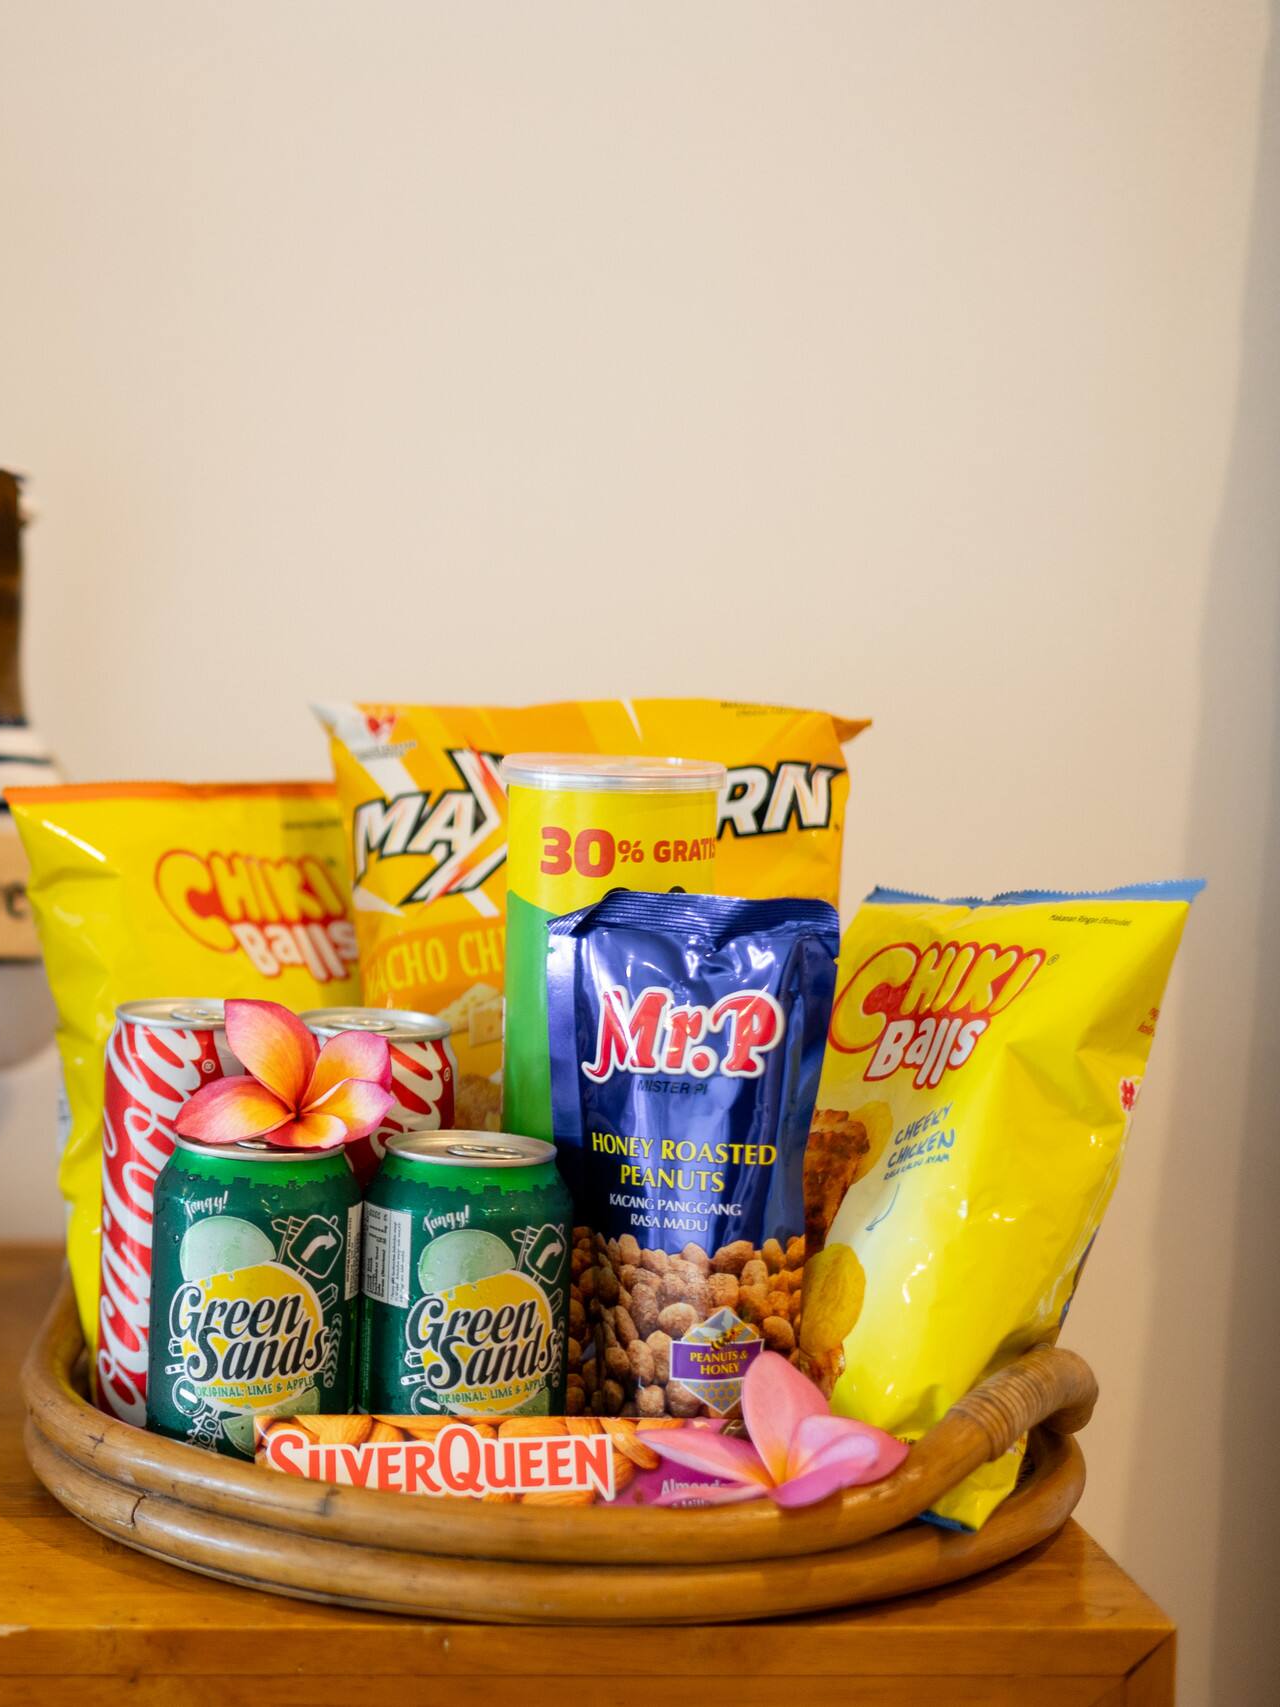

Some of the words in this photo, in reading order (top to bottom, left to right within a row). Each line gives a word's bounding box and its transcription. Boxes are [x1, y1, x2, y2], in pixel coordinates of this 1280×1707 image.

[540, 826, 645, 878] 30%
[154, 848, 348, 954] CHIKI
[232, 919, 359, 983] Balls
[828, 941, 1047, 1054] CHIKI
[863, 1017, 991, 1089] Balls
[636, 1079, 690, 1095] MISTER
[591, 1131, 654, 1158] HONEY
[661, 1139, 778, 1166] ROASTED
[887, 1127, 956, 1168] CHICKEN
[620, 1164, 726, 1193] PEANUTS
[609, 1193, 654, 1211] KACANG
[657, 1199, 743, 1216] PANGGANG
[630, 1213, 661, 1229] RASA
[663, 1217, 709, 1232] MADU
[170, 1285, 306, 1346] Green
[407, 1297, 538, 1353] Green
[185, 1318, 330, 1383] Sands
[426, 1323, 556, 1391] Sands
[689, 1350, 738, 1363] PEANUTS
[740, 1350, 749, 1361] &
[699, 1362, 740, 1375] HONEY
[247, 1383, 273, 1396] LIME
[490, 1387, 513, 1400] LIME
